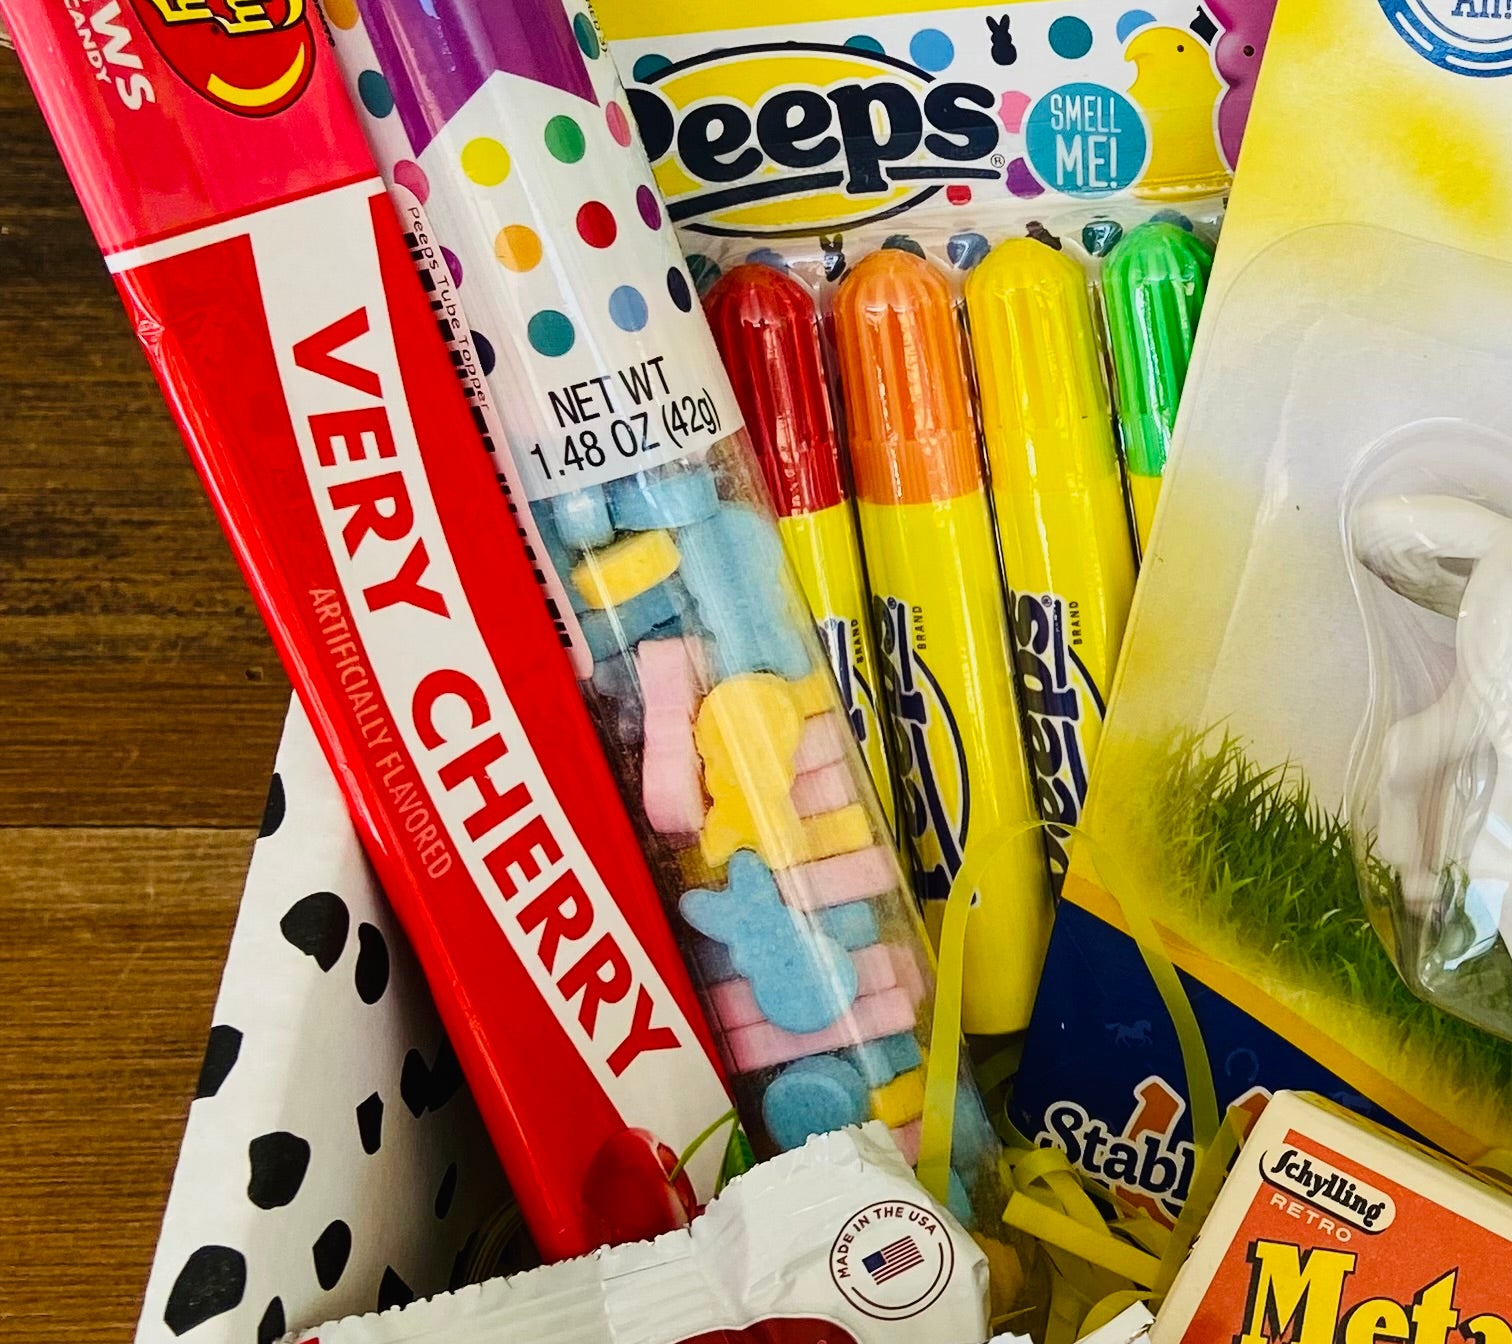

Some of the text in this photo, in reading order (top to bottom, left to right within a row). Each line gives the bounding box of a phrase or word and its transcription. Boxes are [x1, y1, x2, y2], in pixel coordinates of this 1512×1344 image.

[1050, 94, 1123, 135] SMELL
[1055, 137, 1119, 190] ME!
[408, 207, 489, 410] Peeps Tube Topper
[548, 356, 671, 428] NET WT
[530, 387, 722, 480] 1.48 OZ (42g)
[850, 618, 865, 664] BRAND
[912, 605, 927, 651] BRAND
[1068, 600, 1083, 645] BRAND
[292, 306, 682, 1078] VERY CHERRY
[309, 588, 453, 879] ARTIFICIALLY FLAVORED
[1270, 1149, 1386, 1228] Schylling
[1270, 1193, 1353, 1243] RETRO
[836, 1206, 937, 1279] MADE IN THE USA
